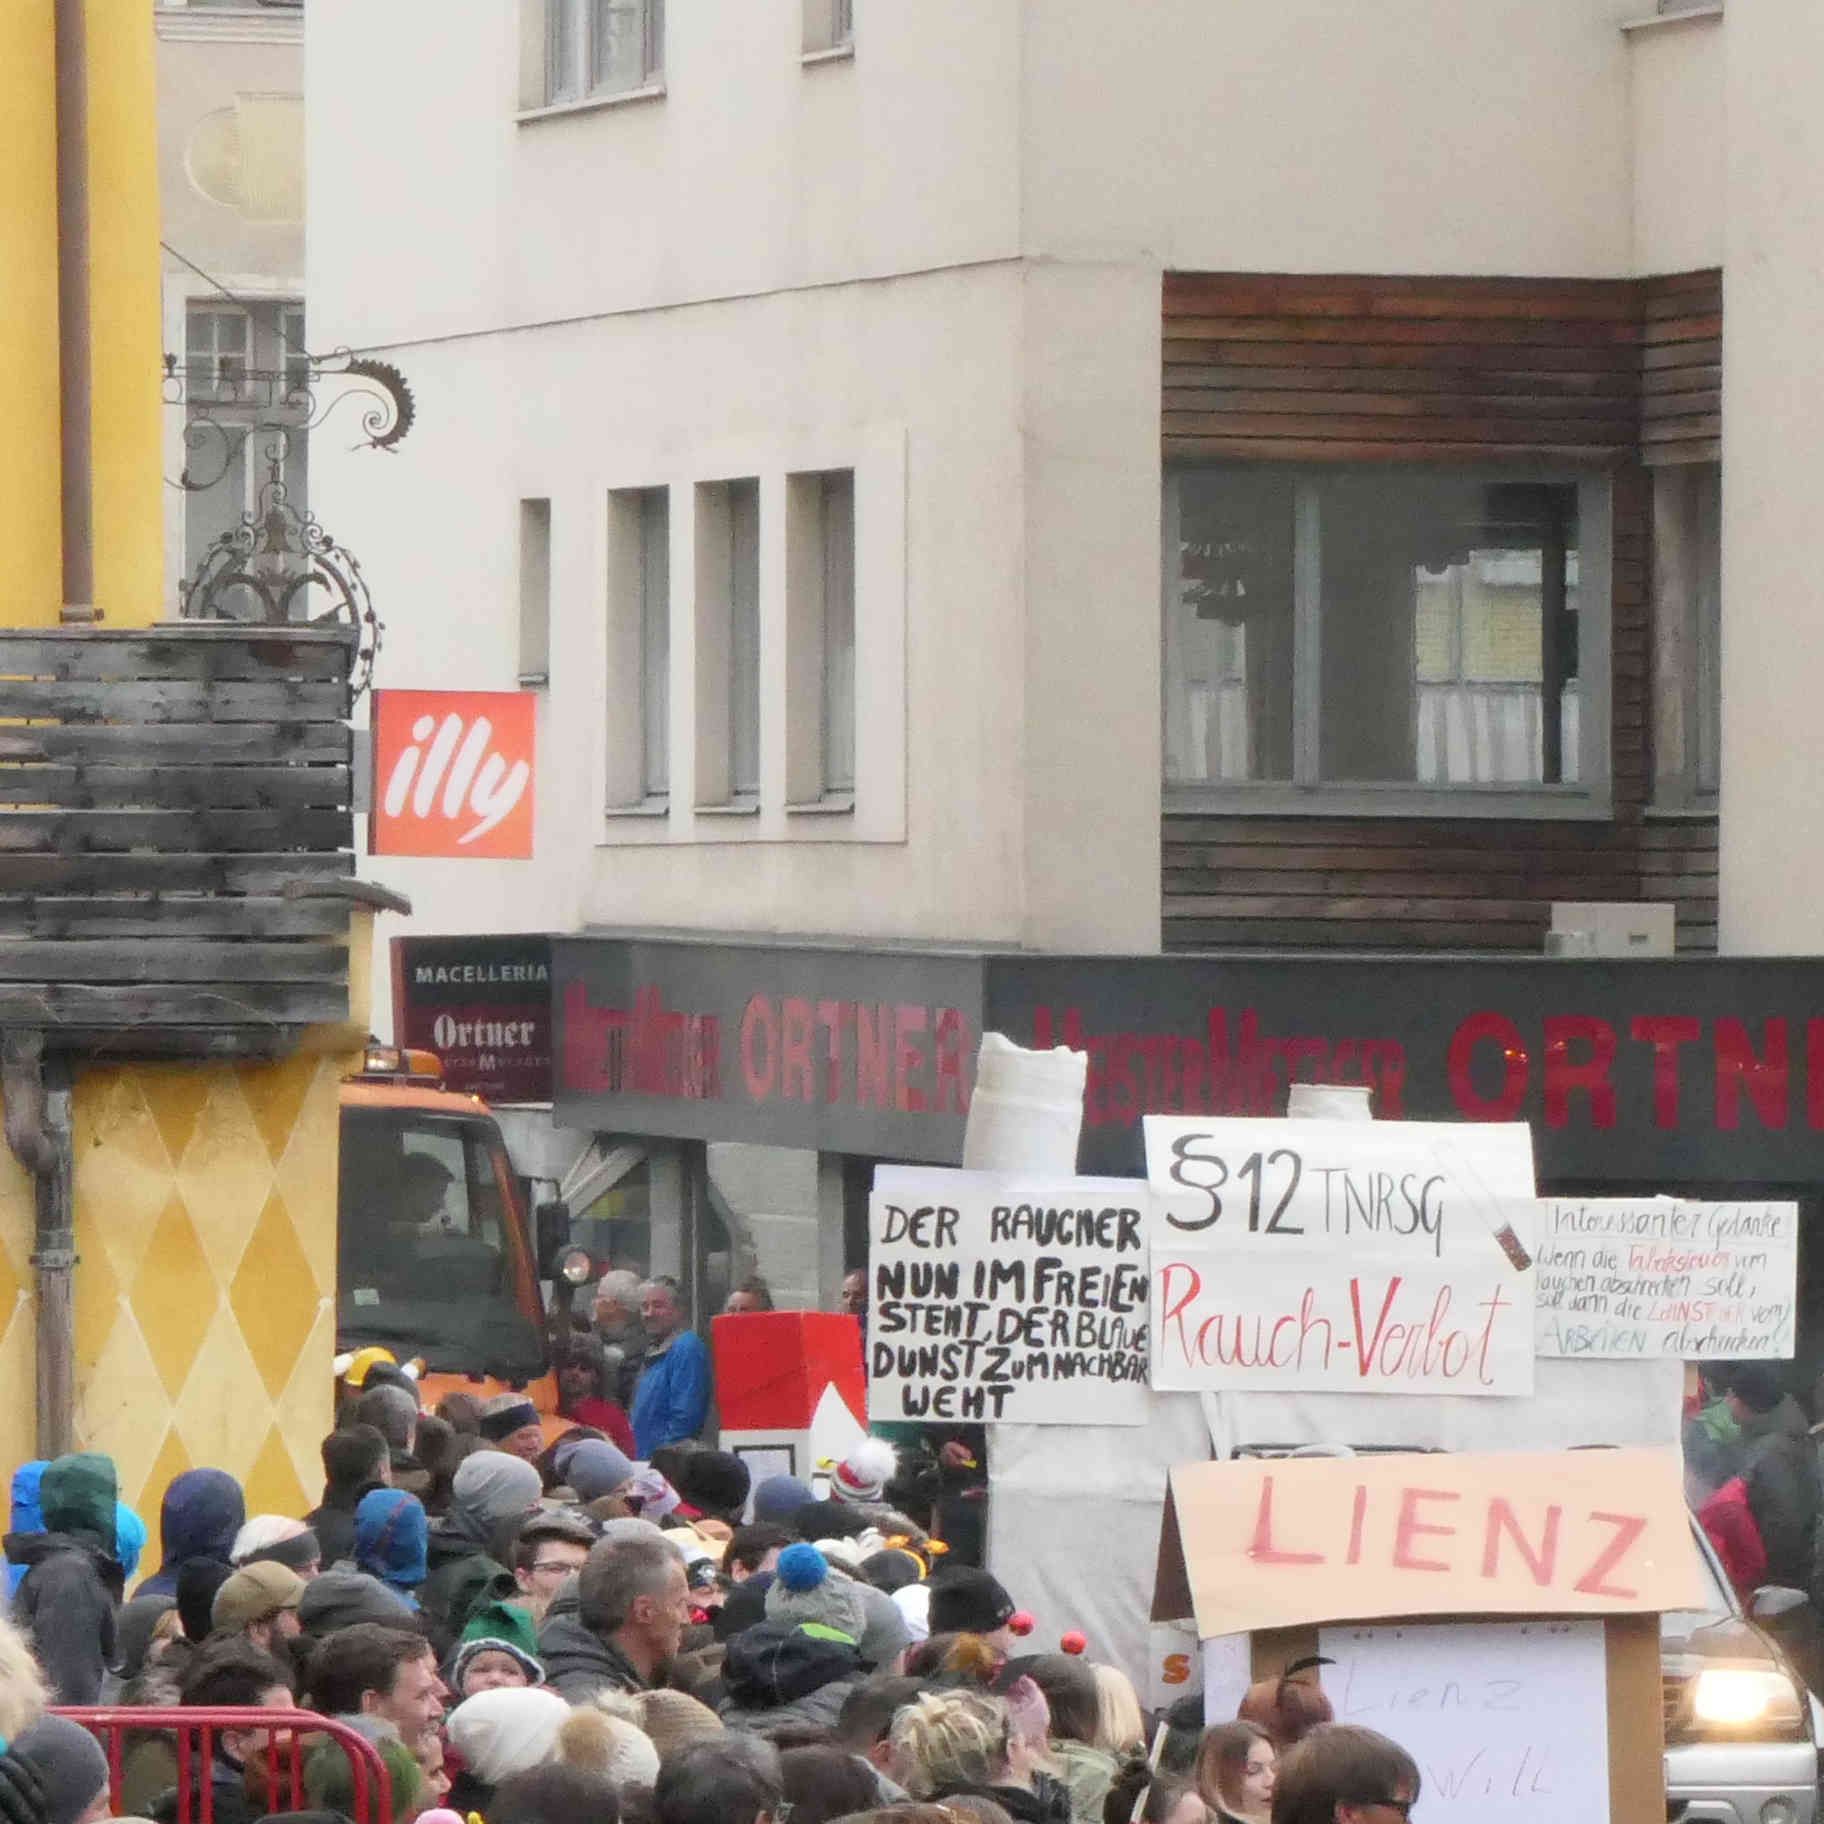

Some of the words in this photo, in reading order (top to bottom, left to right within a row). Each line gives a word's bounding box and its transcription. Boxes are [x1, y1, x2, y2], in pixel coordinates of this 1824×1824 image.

[384, 712, 530, 845] illy
[415, 965, 549, 985] MACELLERIA
[433, 1013, 536, 1048] Ortner
[741, 990, 975, 1114] ORTNER
[880, 1204, 961, 1249] DER
[990, 1204, 1142, 1252] RAUCHER
[876, 1260, 960, 1301] NUN
[996, 1305, 1070, 1348] DER
[1159, 1262, 1512, 1385] Rauch-Verbot
[872, 1338, 986, 1382] DUNST
[902, 1384, 1015, 1419] WEHT
[1249, 1475, 1648, 1600] LIENZ
